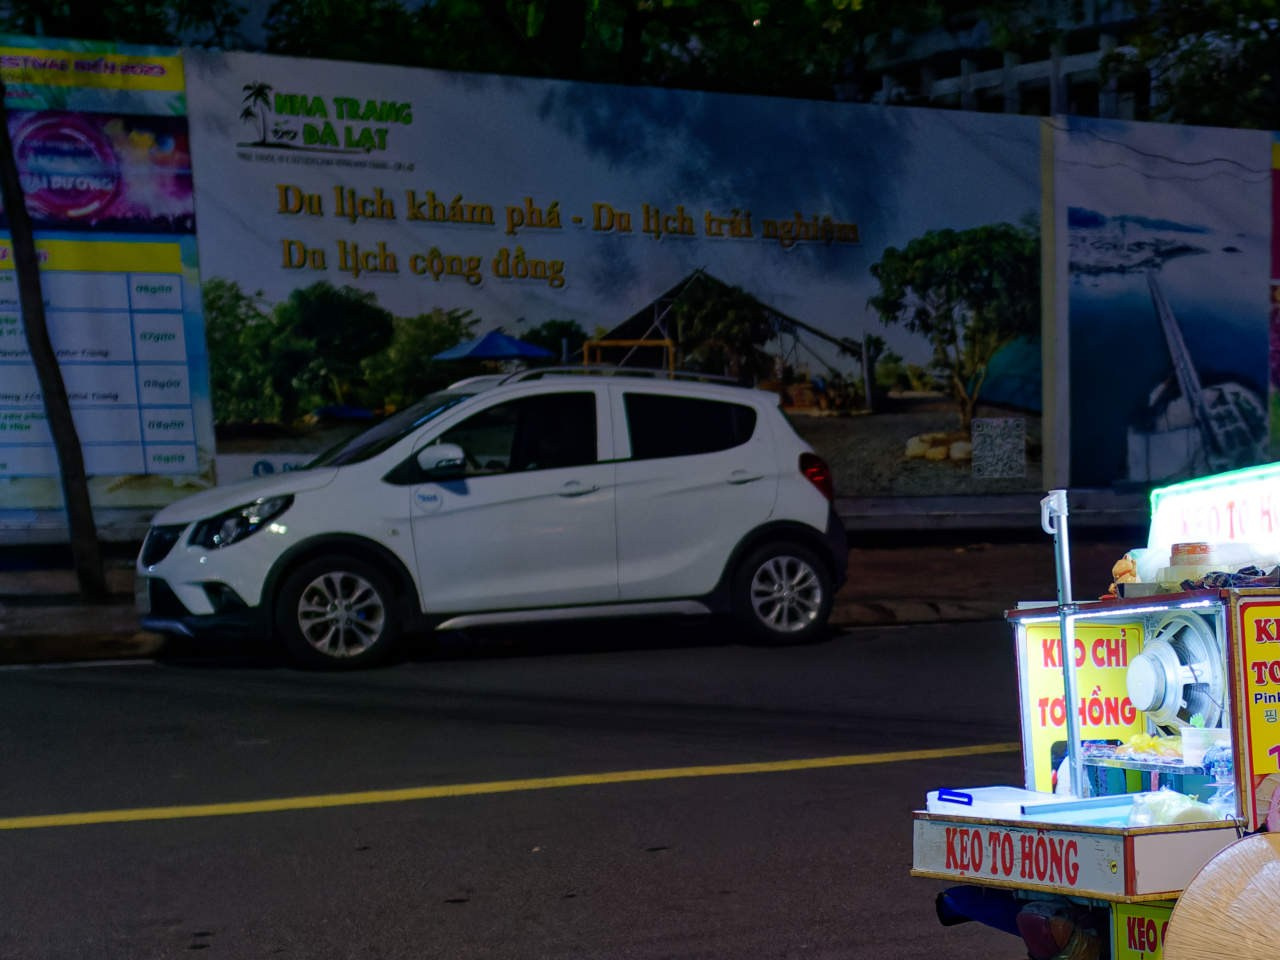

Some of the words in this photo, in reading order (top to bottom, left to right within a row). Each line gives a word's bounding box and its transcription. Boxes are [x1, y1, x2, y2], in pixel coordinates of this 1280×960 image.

[274, 92, 328, 118] NHA
[333, 97, 413, 125] TRANG
[345, 125, 388, 154] LẠT
[276, 184, 323, 216] Du
[333, 185, 396, 223] lịch
[406, 190, 496, 225] khám
[505, 196, 563, 236] phá
[592, 203, 632, 233] Du
[642, 203, 696, 240] lịch
[704, 208, 753, 238] trải
[762, 211, 860, 248] nghiệm
[281, 239, 327, 270] Du
[336, 239, 398, 278] lịch
[410, 246, 482, 285] cộng
[492, 245, 565, 288] đồng
[1091, 628, 1128, 668] CHỈ
[945, 827, 984, 876] KẸO
[1126, 916, 1158, 960] KẸO
